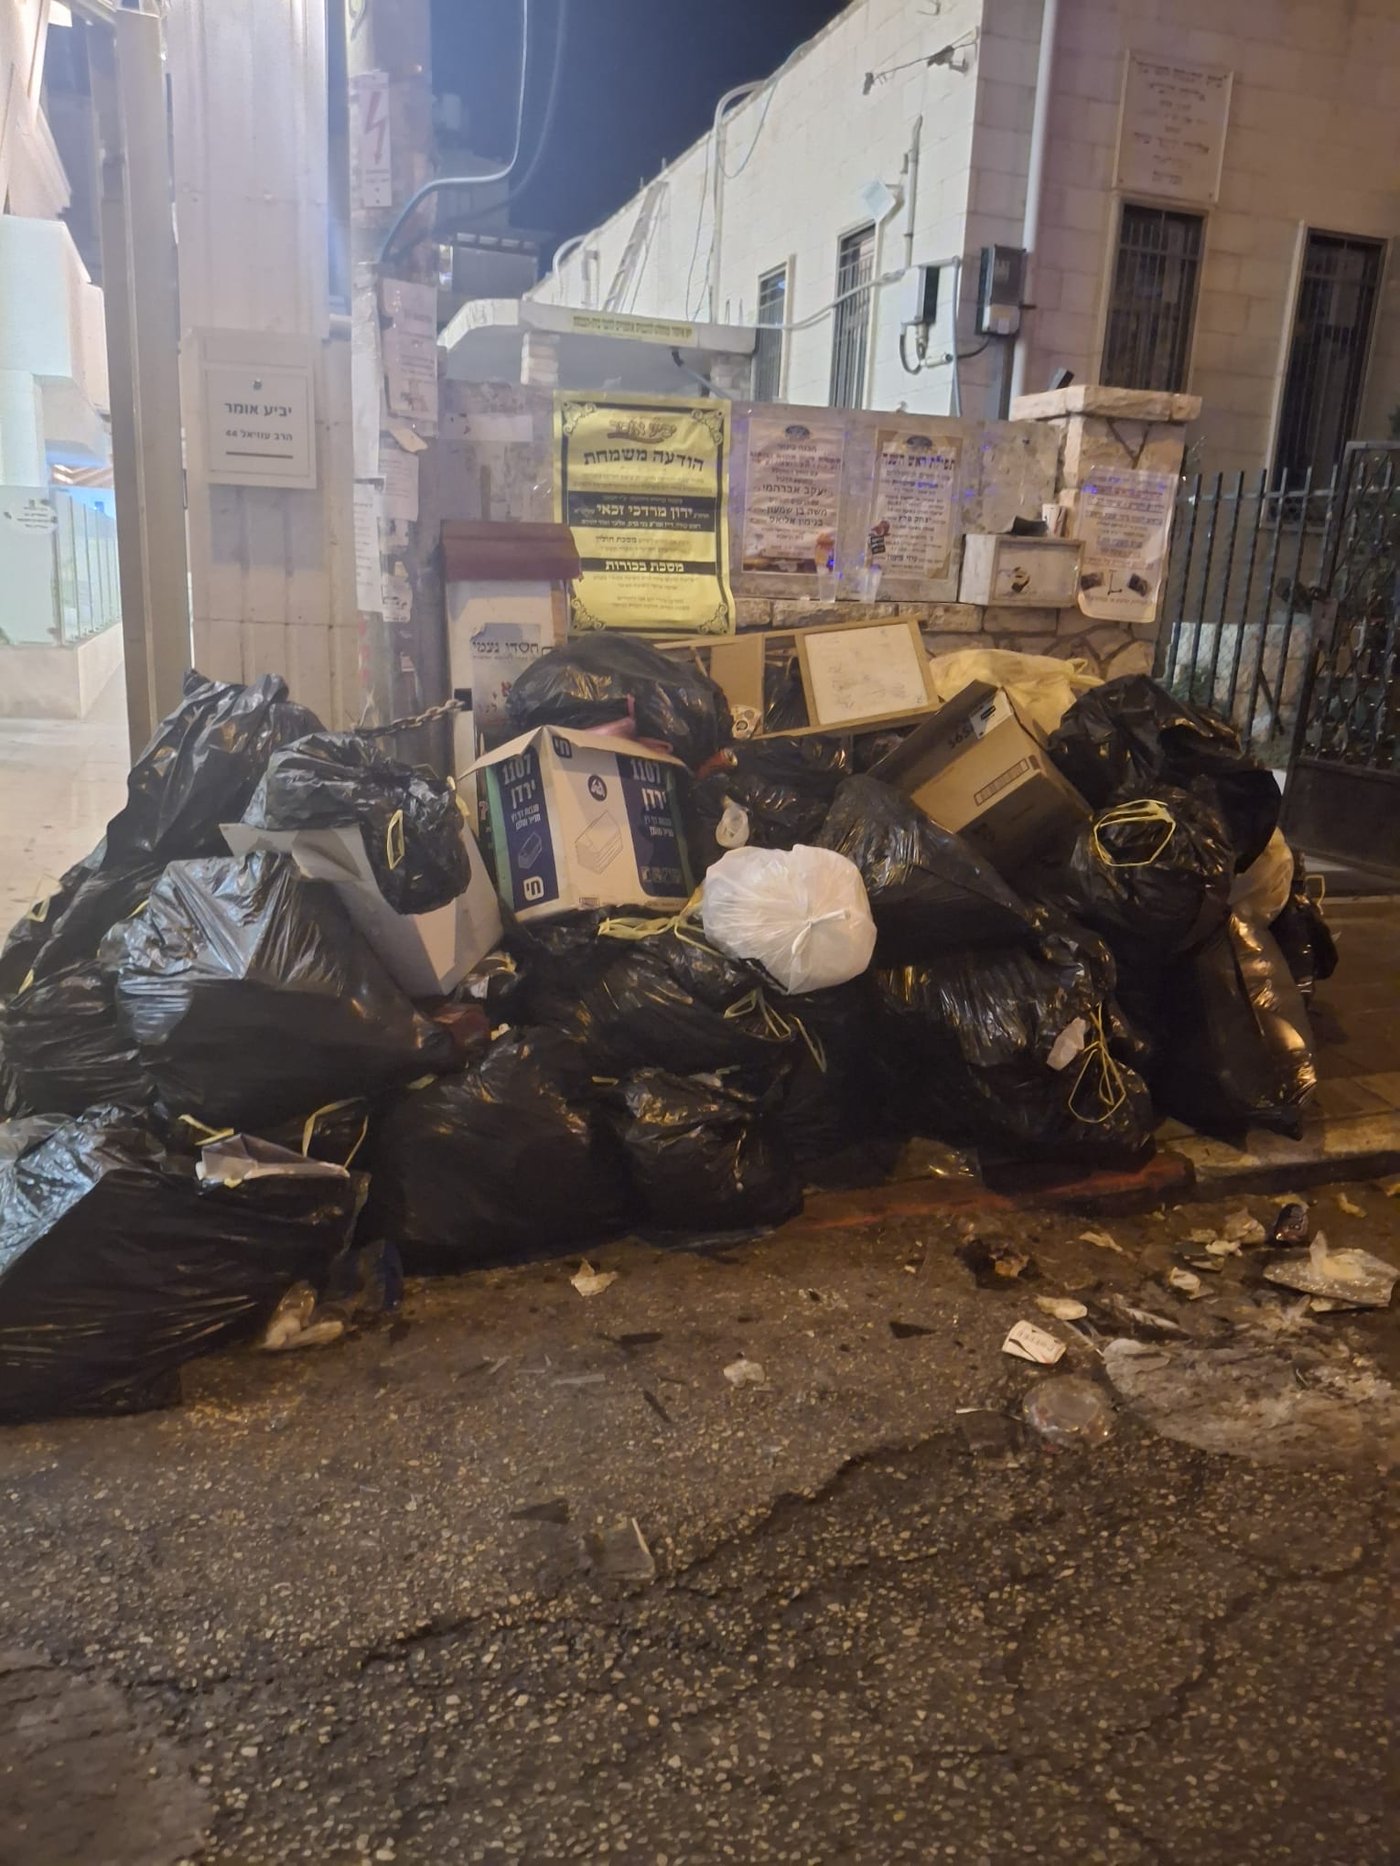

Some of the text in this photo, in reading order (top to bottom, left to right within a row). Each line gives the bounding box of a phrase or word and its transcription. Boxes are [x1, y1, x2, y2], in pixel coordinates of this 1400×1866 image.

[225, 402, 292, 417] יביע אומר
[273, 432, 293, 441] הרב
[583, 447, 704, 471] הודעה משמחת
[804, 486, 828, 497] יעקב
[597, 503, 625, 516] זכאי
[628, 505, 667, 517] מרדכי
[807, 508, 828, 517] משה
[605, 560, 685, 573] מסכת בכורות
[472, 640, 539, 654] חסדי נעמי
[502, 753, 532, 785] 1107
[630, 758, 661, 784] 1107
